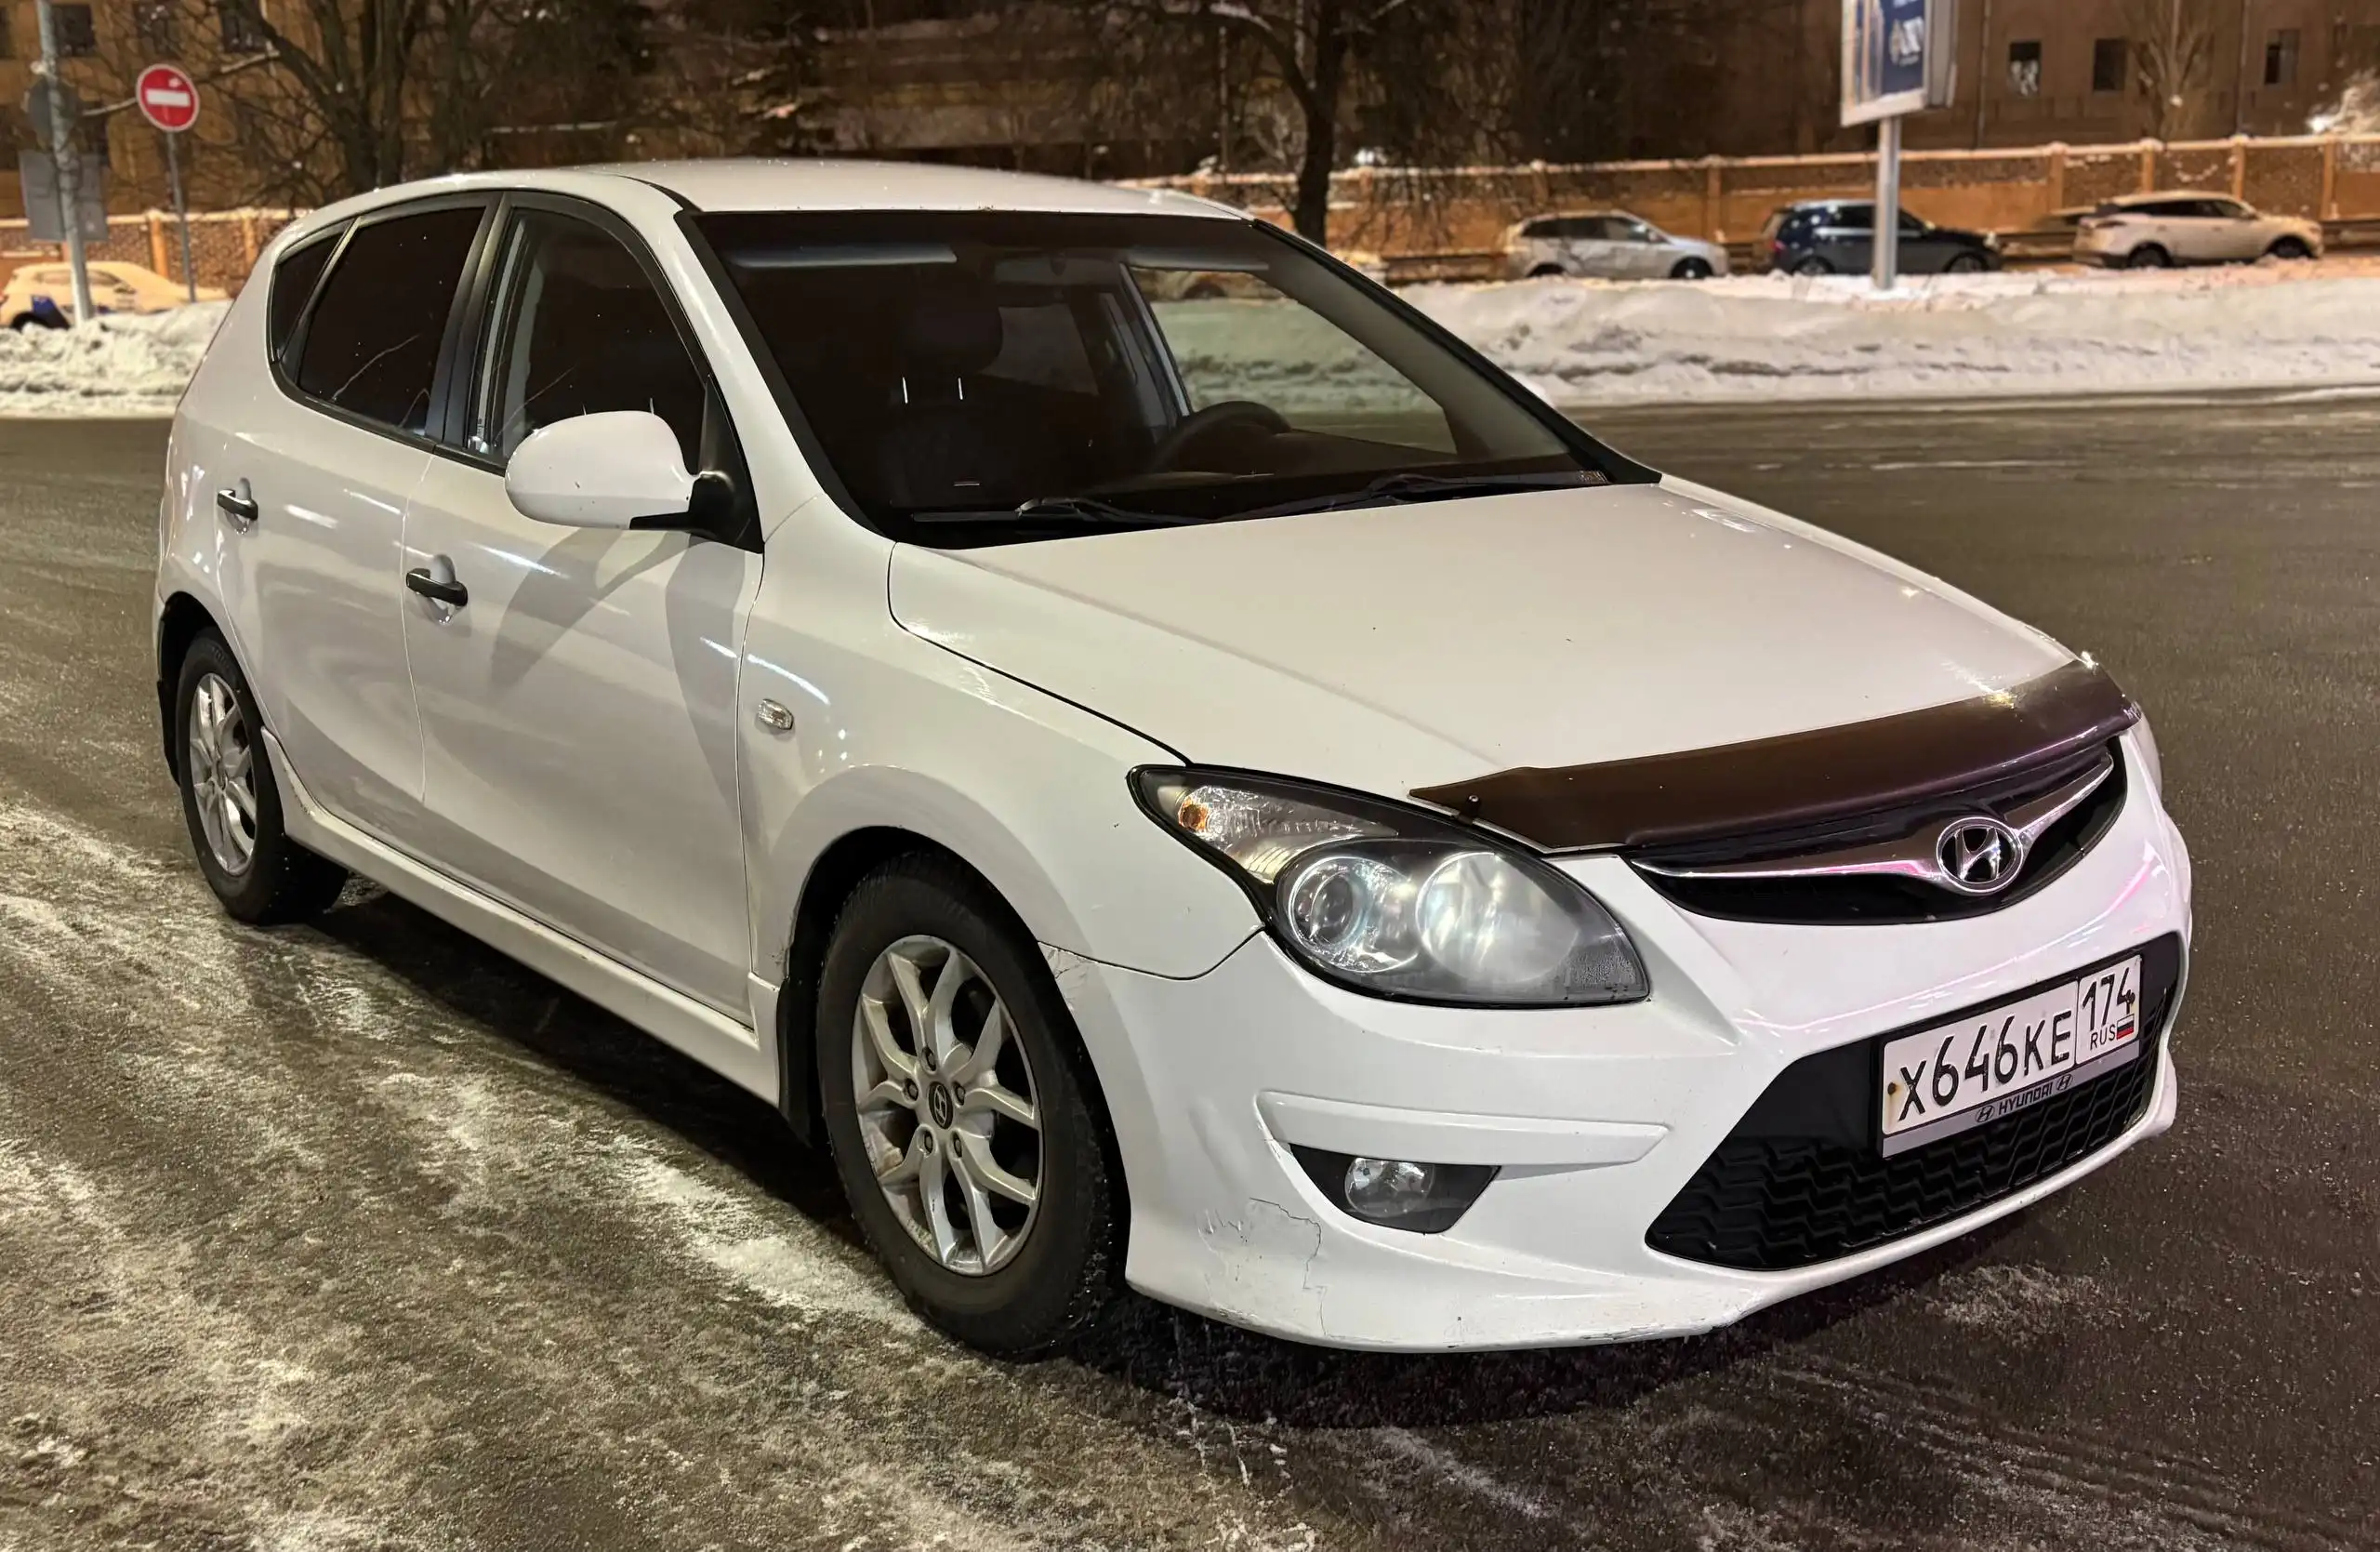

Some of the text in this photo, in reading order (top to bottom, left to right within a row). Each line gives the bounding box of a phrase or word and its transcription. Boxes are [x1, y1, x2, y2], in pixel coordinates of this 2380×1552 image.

[2082, 967, 2135, 1030] 174
[2090, 1023, 2116, 1051] RUS
[1998, 1082, 2054, 1114] HYUNDAI
